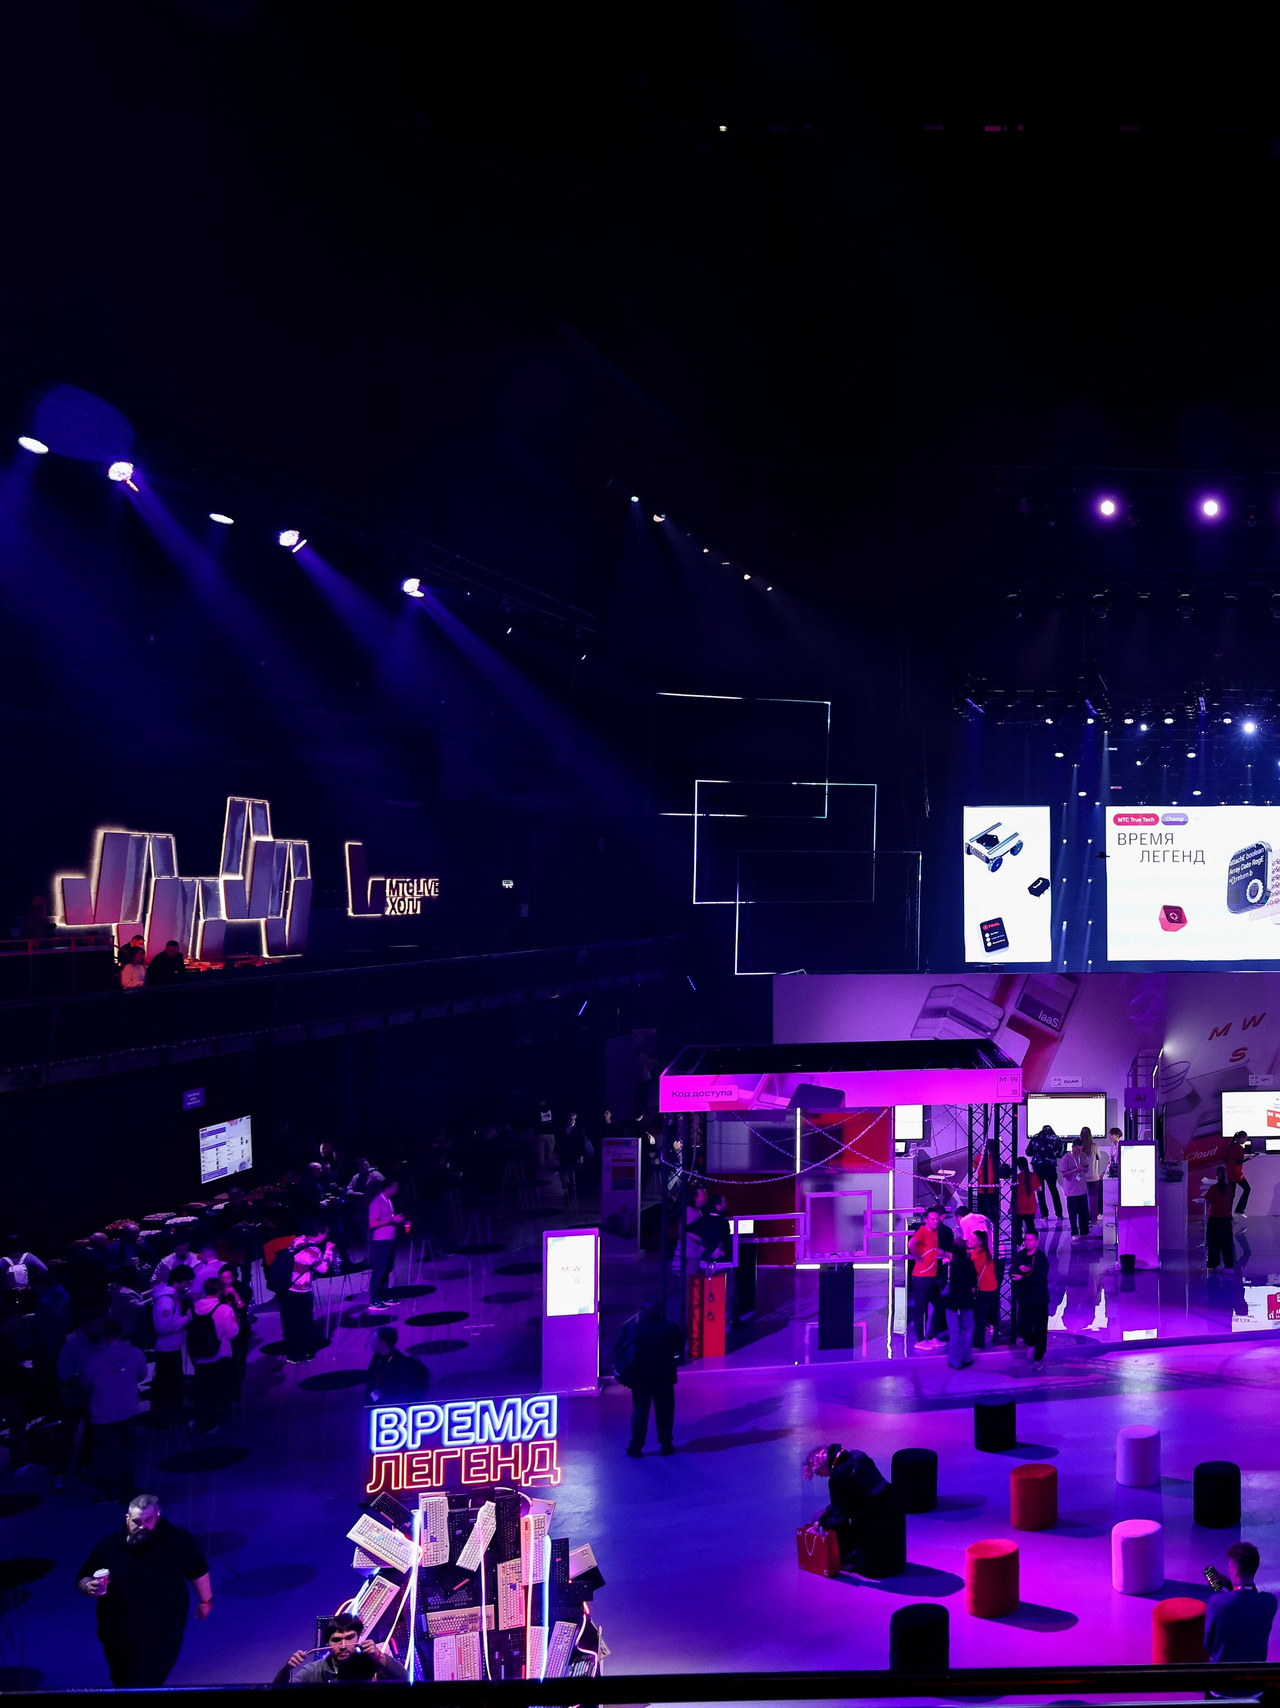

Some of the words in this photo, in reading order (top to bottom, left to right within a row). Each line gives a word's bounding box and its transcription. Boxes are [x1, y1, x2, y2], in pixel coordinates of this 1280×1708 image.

[1117, 832, 1174, 846] ВРЕМЯ
[1139, 850, 1206, 865] ЛЕГЕНД
[1038, 1010, 1060, 1028] IaaS
[671, 1090, 691, 1099] Код
[692, 1089, 733, 1099] доступа
[1133, 1093, 1147, 1103] AI
[1186, 1146, 1219, 1161] Cloud
[370, 1394, 559, 1454] ВРЕМЯ
[366, 1439, 561, 1494] ЛЕГЕНД
